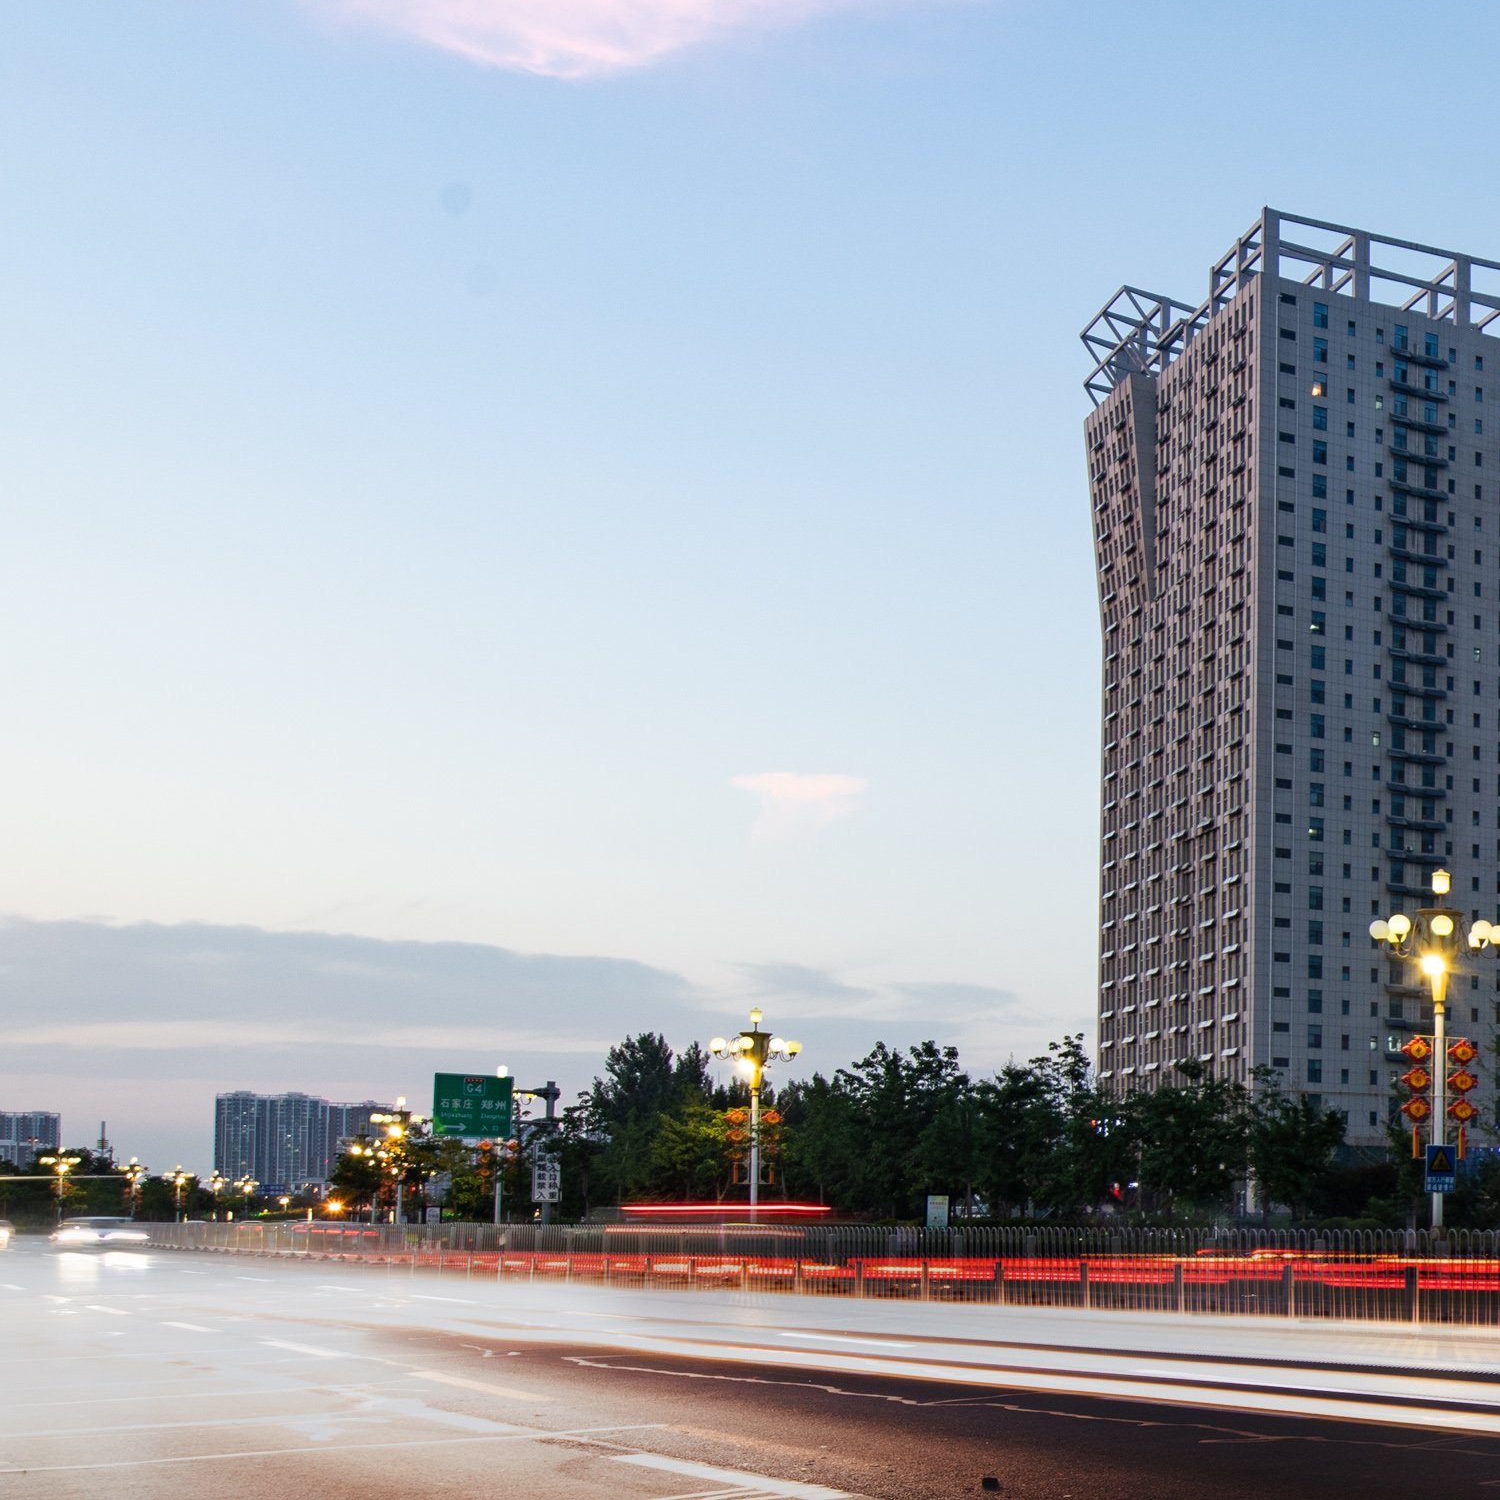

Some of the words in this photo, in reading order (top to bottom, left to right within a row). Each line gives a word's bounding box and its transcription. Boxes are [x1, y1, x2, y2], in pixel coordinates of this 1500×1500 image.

[466, 1083, 482, 1093] G4
[440, 1098, 473, 1109] 石家庄
[480, 1099, 507, 1111] 郑州
[481, 1124, 499, 1132] 入口
